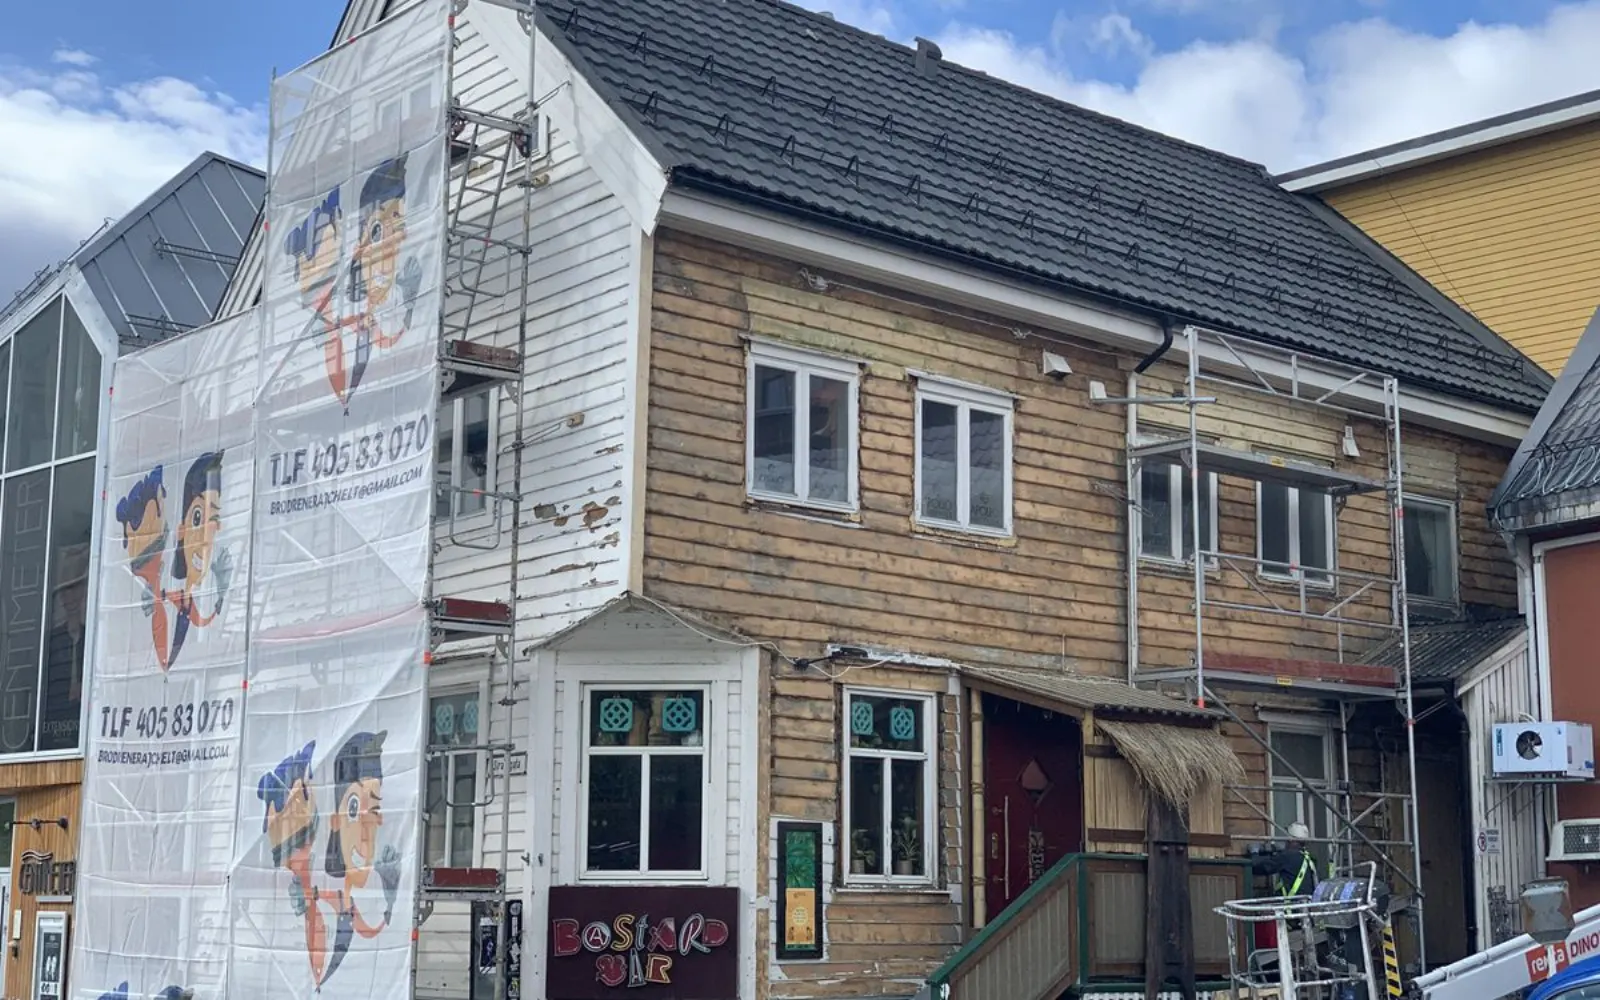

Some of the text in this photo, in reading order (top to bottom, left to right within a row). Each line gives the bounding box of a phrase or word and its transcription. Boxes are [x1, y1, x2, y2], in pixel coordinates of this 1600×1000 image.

[270, 413, 429, 487] TLF 405 83 070
[2, 477, 45, 749] CENTIMETER
[101, 697, 234, 738] TLF 405 83 070
